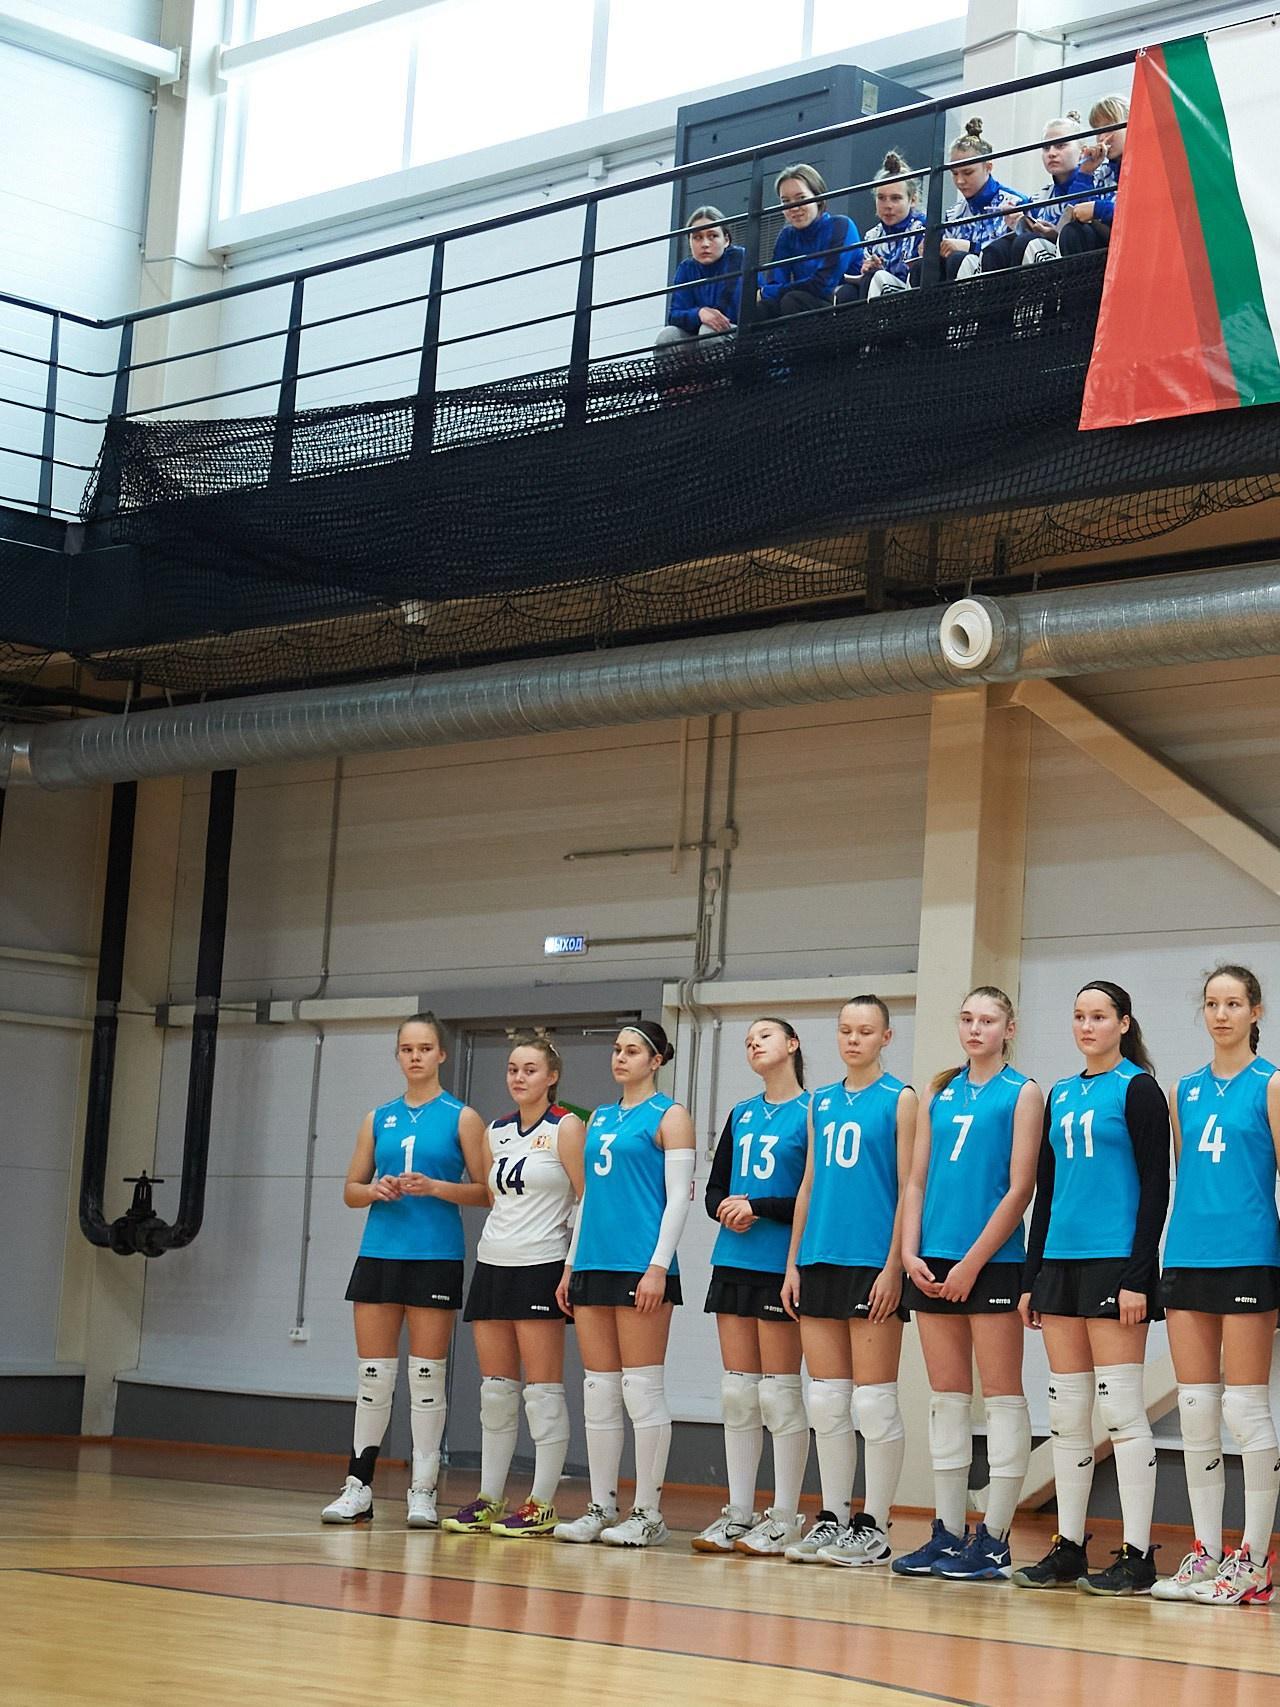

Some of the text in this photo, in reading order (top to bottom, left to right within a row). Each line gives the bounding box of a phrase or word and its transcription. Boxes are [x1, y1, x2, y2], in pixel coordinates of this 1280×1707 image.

[545, 937, 583, 952] ЫХОД
[400, 1135, 416, 1174] 1
[594, 1133, 617, 1177] 3
[738, 1133, 780, 1180] 13
[822, 1121, 862, 1169] 10
[949, 1114, 974, 1162] 7
[1060, 1109, 1095, 1159] 11
[1198, 1113, 1226, 1163] 4
[495, 1156, 528, 1196] 14
